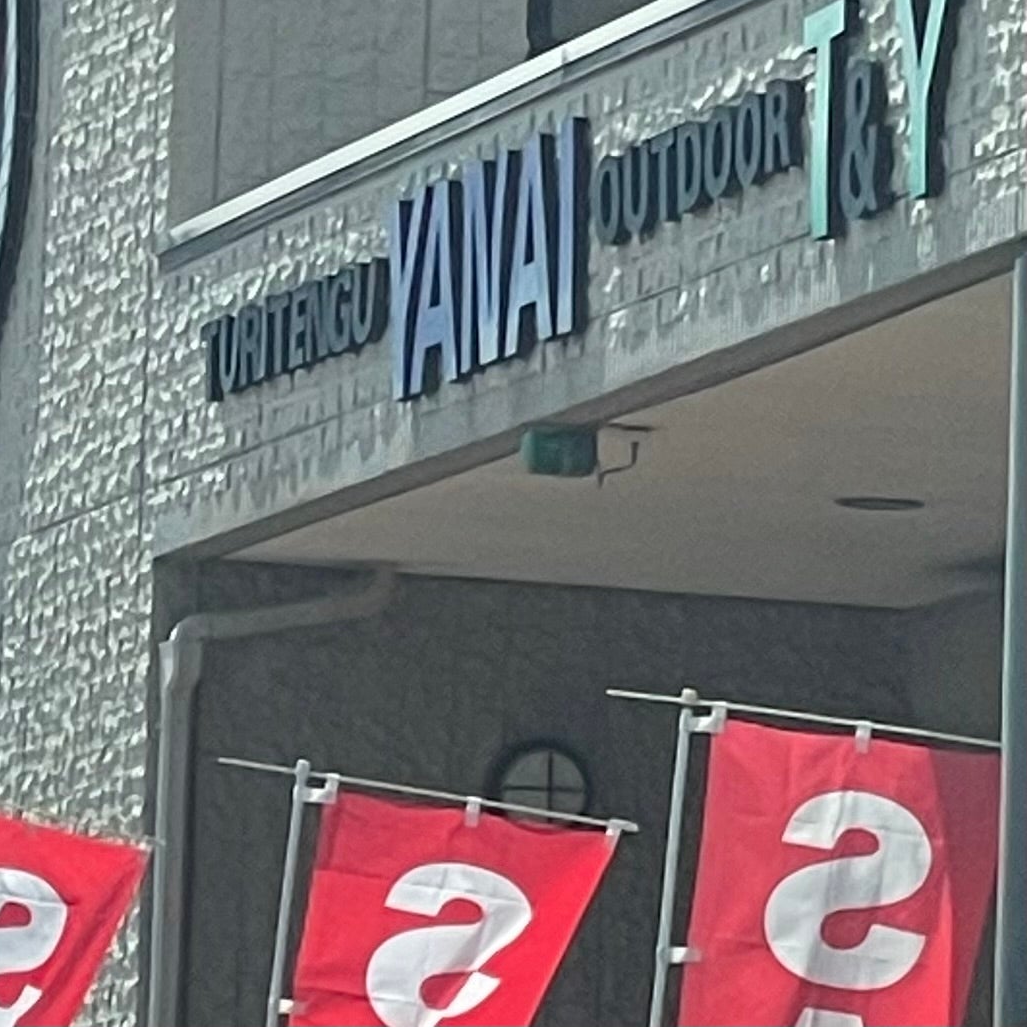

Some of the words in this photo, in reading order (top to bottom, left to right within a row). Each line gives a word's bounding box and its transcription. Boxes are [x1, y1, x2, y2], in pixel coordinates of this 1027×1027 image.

[201, 257, 386, 402] TURITENGU
[389, 116, 584, 402] YANAI
[593, 78, 798, 245] OUTDOOR
